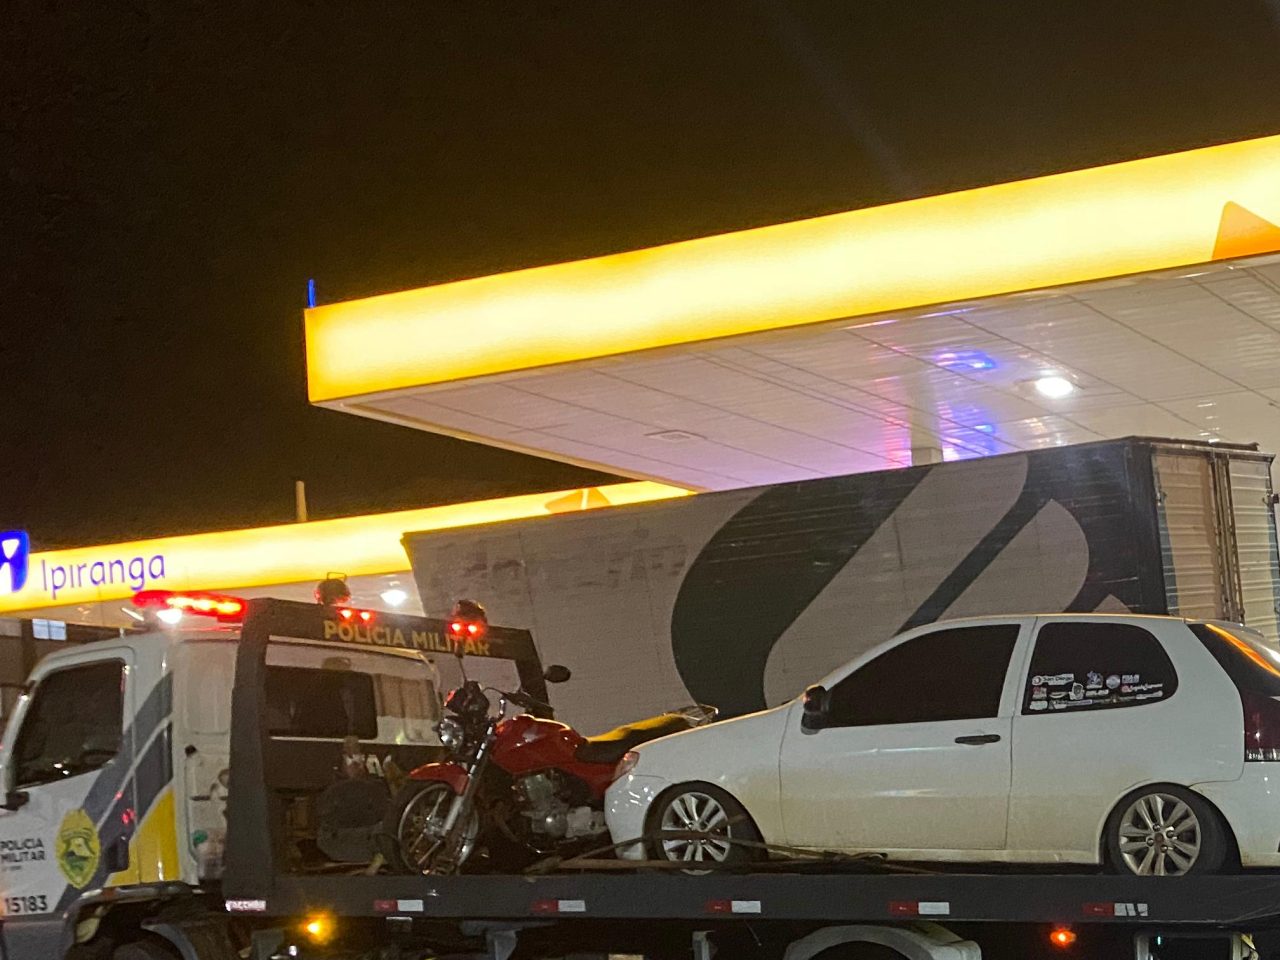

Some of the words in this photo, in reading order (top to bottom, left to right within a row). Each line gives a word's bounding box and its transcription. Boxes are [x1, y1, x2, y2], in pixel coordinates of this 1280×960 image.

[41, 555, 166, 601] Ipiranga
[0, 851, 45, 863] MILITAR
[5, 894, 48, 913] 15183
